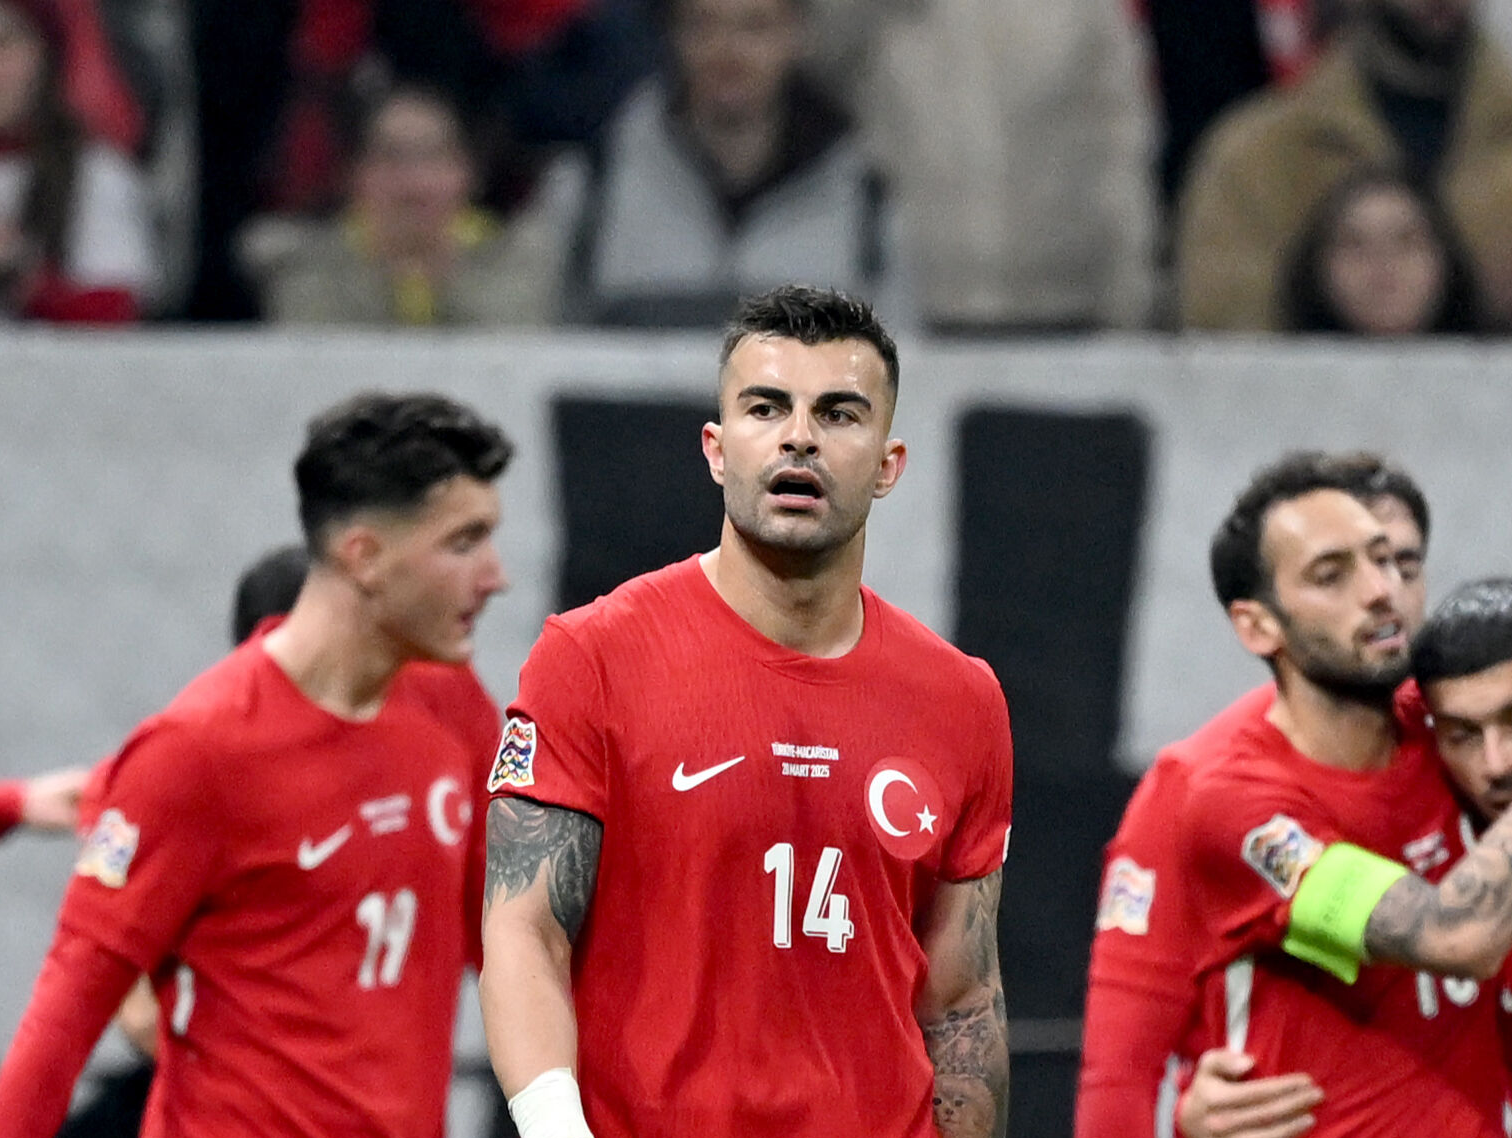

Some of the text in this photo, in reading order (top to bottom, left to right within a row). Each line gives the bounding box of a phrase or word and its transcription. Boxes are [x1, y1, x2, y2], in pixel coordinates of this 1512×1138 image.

[810, 764, 830, 777] 2025
[356, 890, 417, 988] 19
[764, 843, 854, 953] 14
